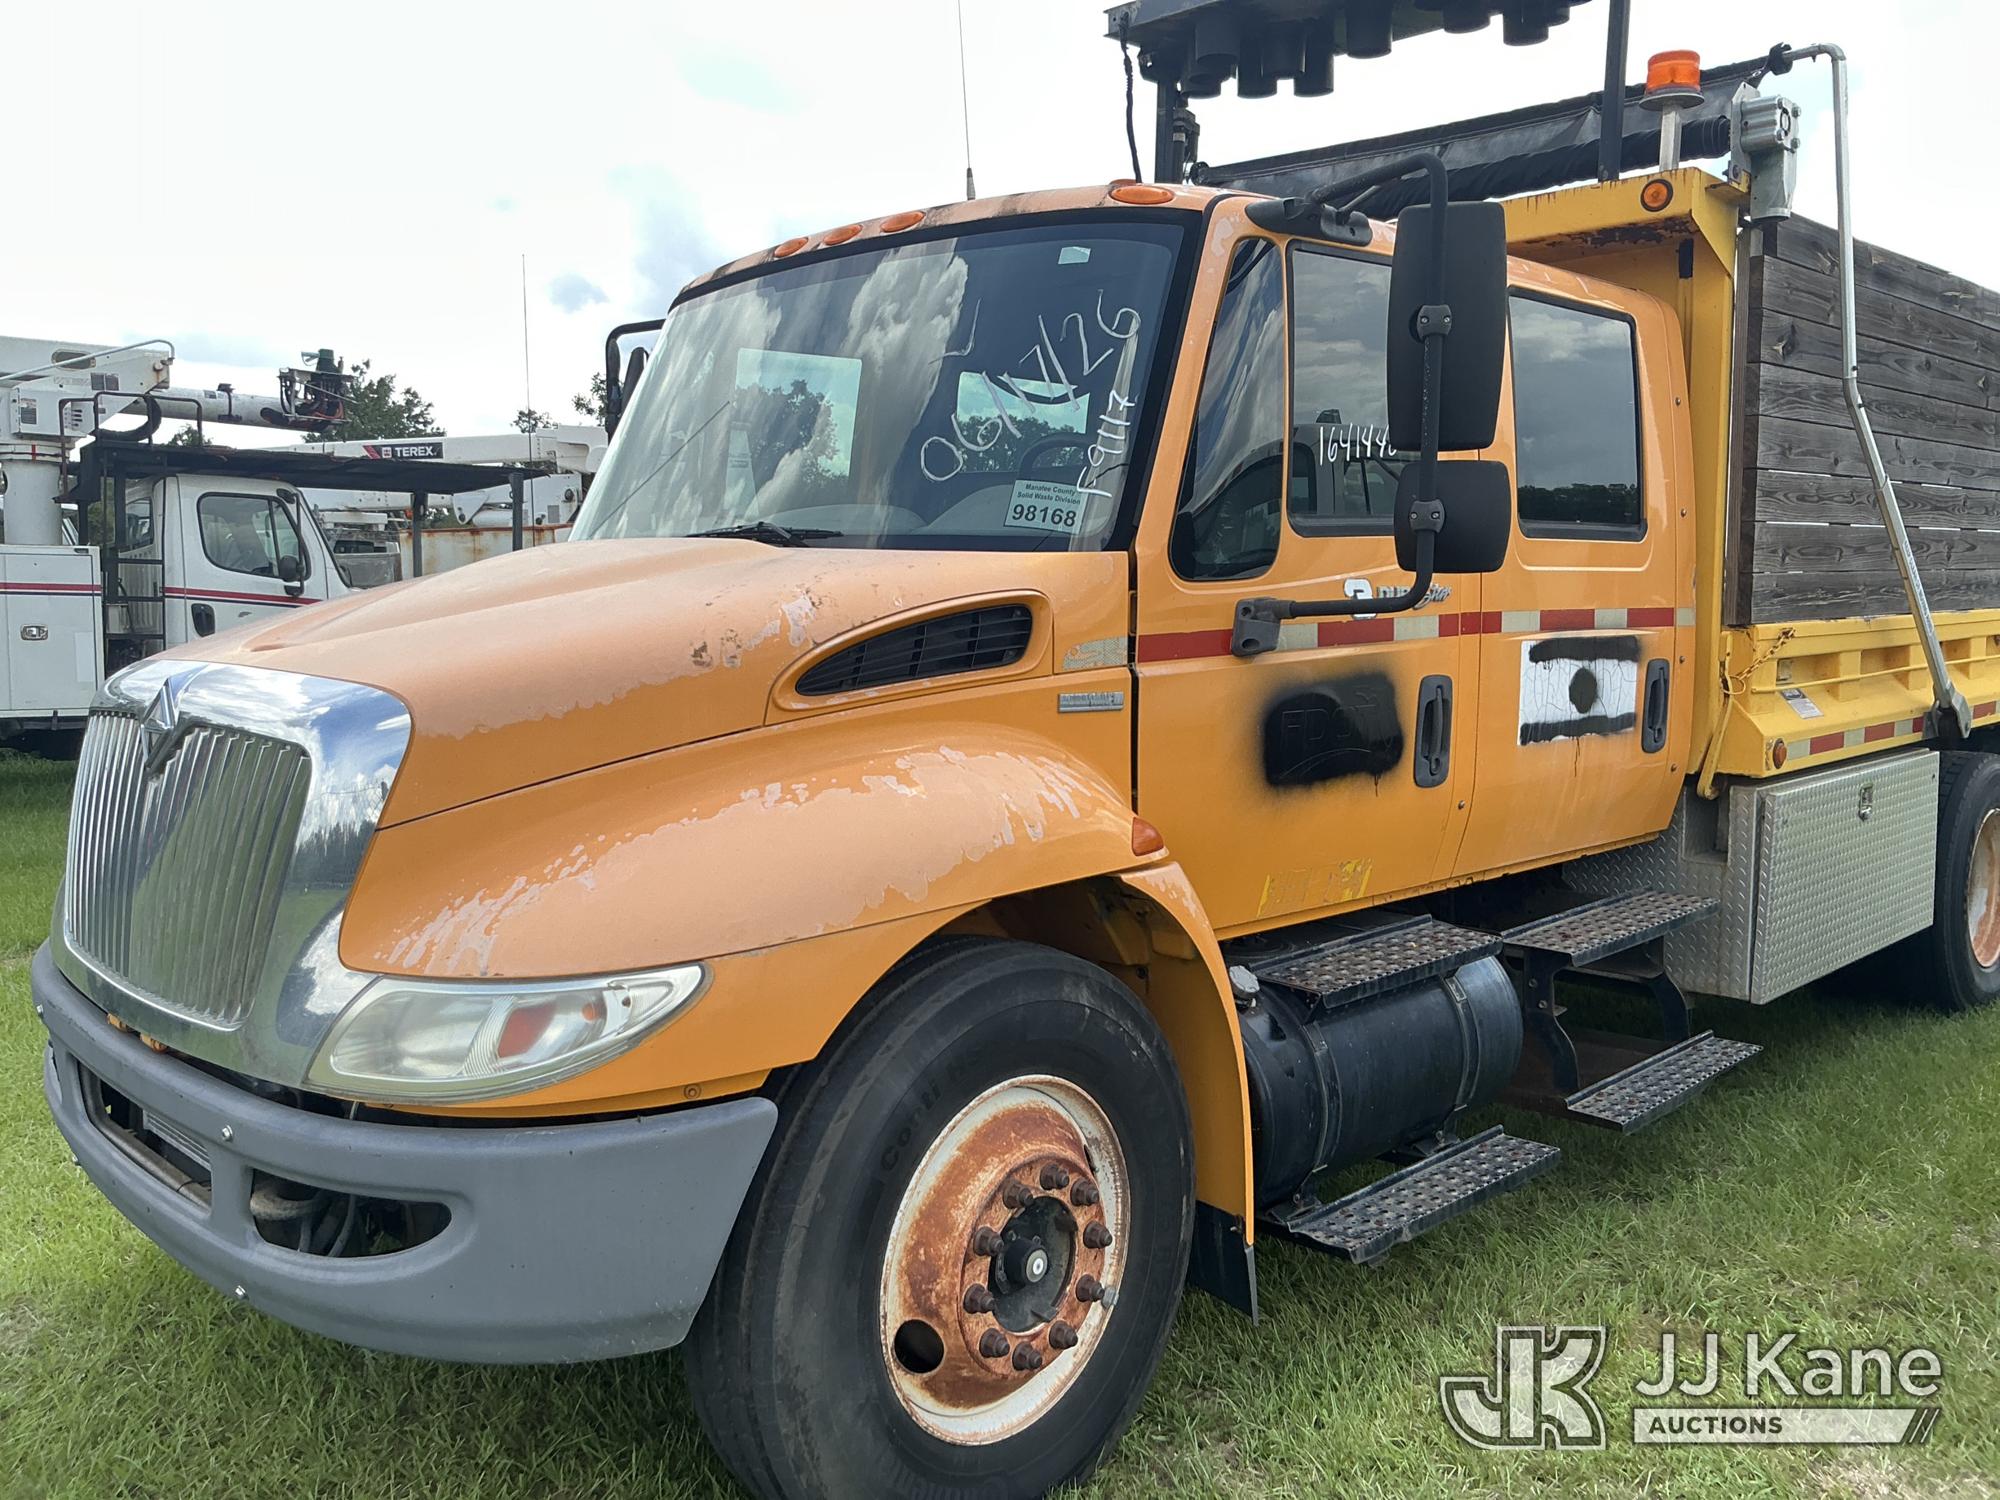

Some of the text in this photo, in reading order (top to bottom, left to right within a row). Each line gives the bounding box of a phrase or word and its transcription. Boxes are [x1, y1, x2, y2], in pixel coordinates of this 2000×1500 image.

[395, 446, 433, 457] TEREX
[1025, 483, 1076, 497] Manatee County
[1017, 491, 1080, 505] Solid Waste Division
[1012, 503, 1077, 527] 98168
